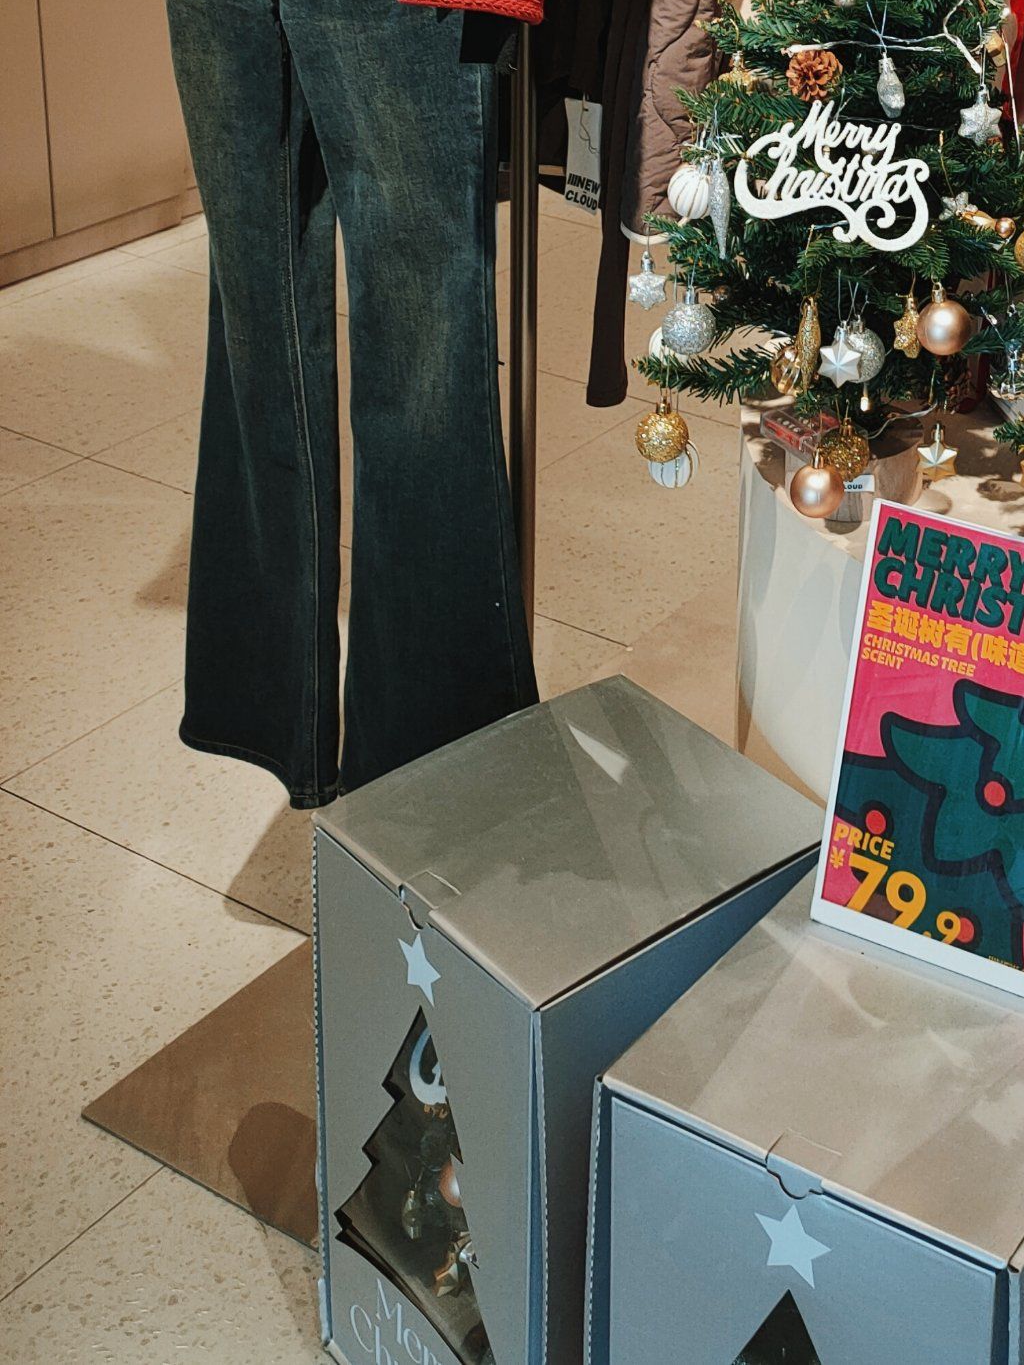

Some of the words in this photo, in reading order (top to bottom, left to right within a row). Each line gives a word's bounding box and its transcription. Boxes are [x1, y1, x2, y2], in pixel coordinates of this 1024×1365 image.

[777, 99, 902, 168] Merry
[733, 122, 930, 252] Christmas
[861, 647, 904, 670] SCENT
[864, 633, 940, 667] CHRISTMAS
[940, 656, 976, 677] TREE
[833, 823, 895, 861] PRICE
